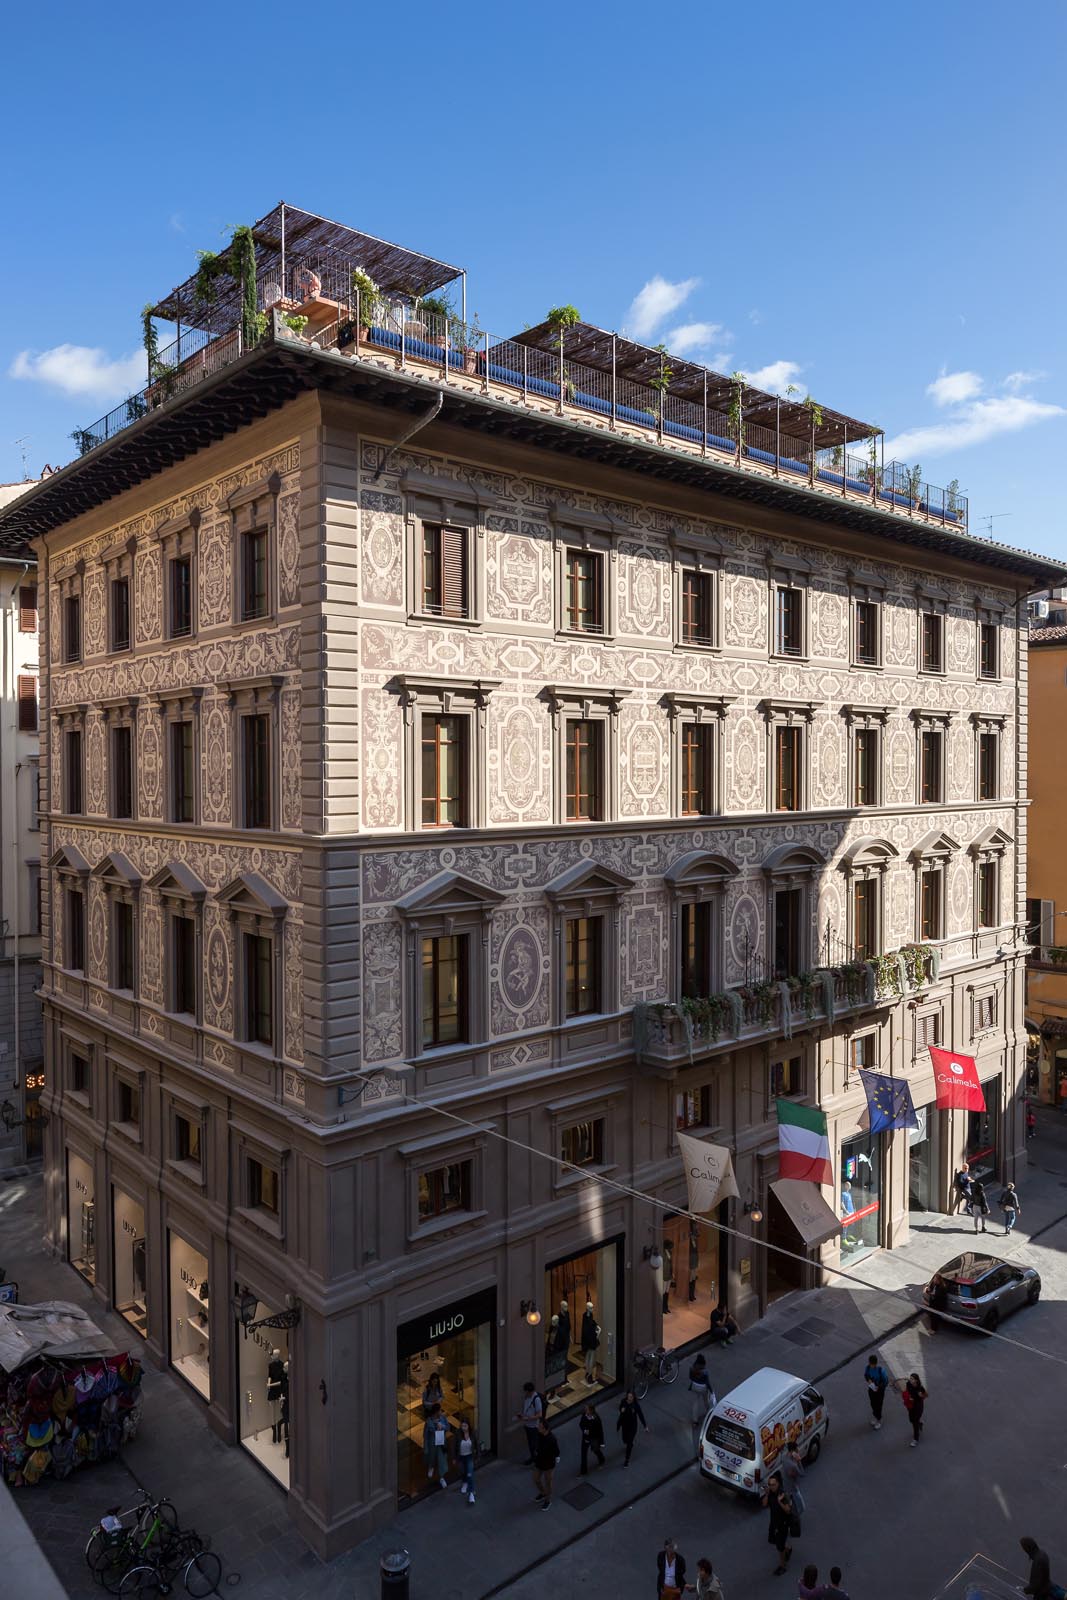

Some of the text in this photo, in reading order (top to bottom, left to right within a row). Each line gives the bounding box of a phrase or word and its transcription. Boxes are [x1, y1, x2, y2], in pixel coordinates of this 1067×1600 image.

[937, 1073, 979, 1089] Calimala
[690, 1167, 731, 1184] Calim
[724, 1408, 747, 1422] 4242
